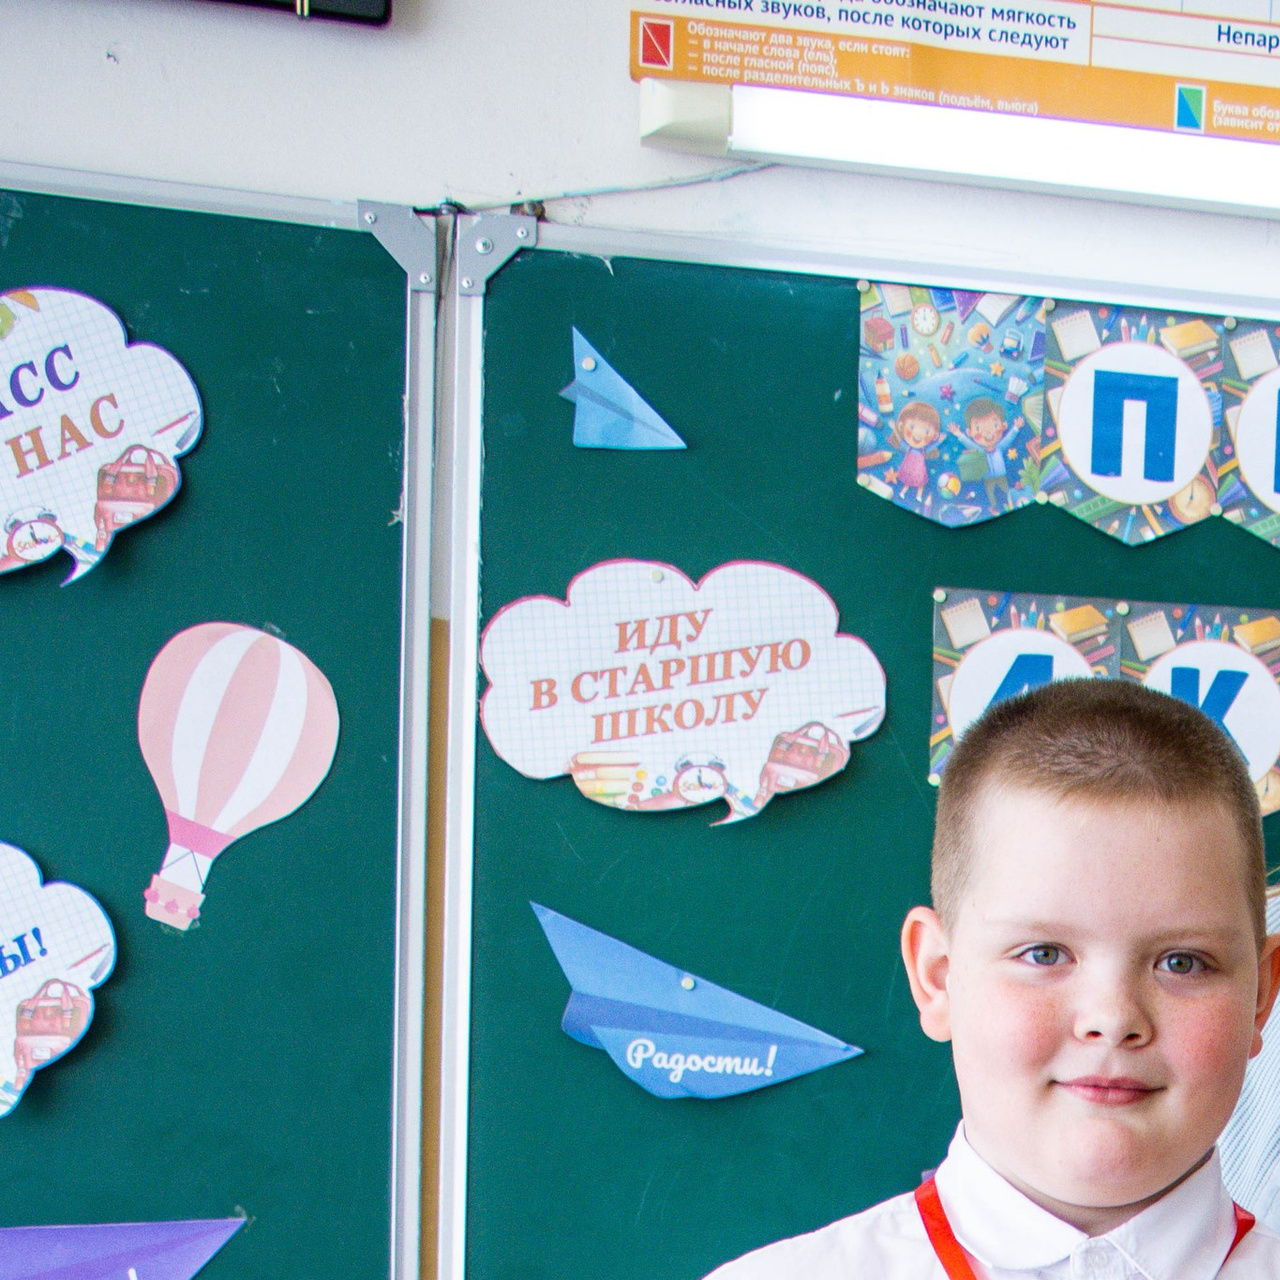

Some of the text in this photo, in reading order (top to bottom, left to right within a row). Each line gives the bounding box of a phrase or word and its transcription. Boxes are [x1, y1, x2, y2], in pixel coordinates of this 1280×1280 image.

[687, 21, 910, 58] Обозначают два звука, если стоят:
[838, 8, 895, 26] после
[901, 16, 981, 39] которых
[988, 27, 1070, 50] следуют
[991, 8, 1077, 30] мягкость
[703, 52, 740, 65] после
[744, 54, 794, 71] гласной
[798, 60, 838, 77] (пояс),
[714, 41, 759, 55] начале
[763, 46, 800, 59] слова
[803, 49, 838, 64] (ель),
[703, 64, 740, 79] после
[744, 70, 850, 91] разделительных
[894, 85, 935, 102] знаков
[0, 343, 80, 419] СС
[4, 392, 125, 479] НАС
[615, 608, 713, 655] ИДУ
[530, 638, 811, 710] В СТАРШУЮ
[590, 688, 769, 743] ШКОЛУ
[626, 1038, 778, 1083] Радости!
